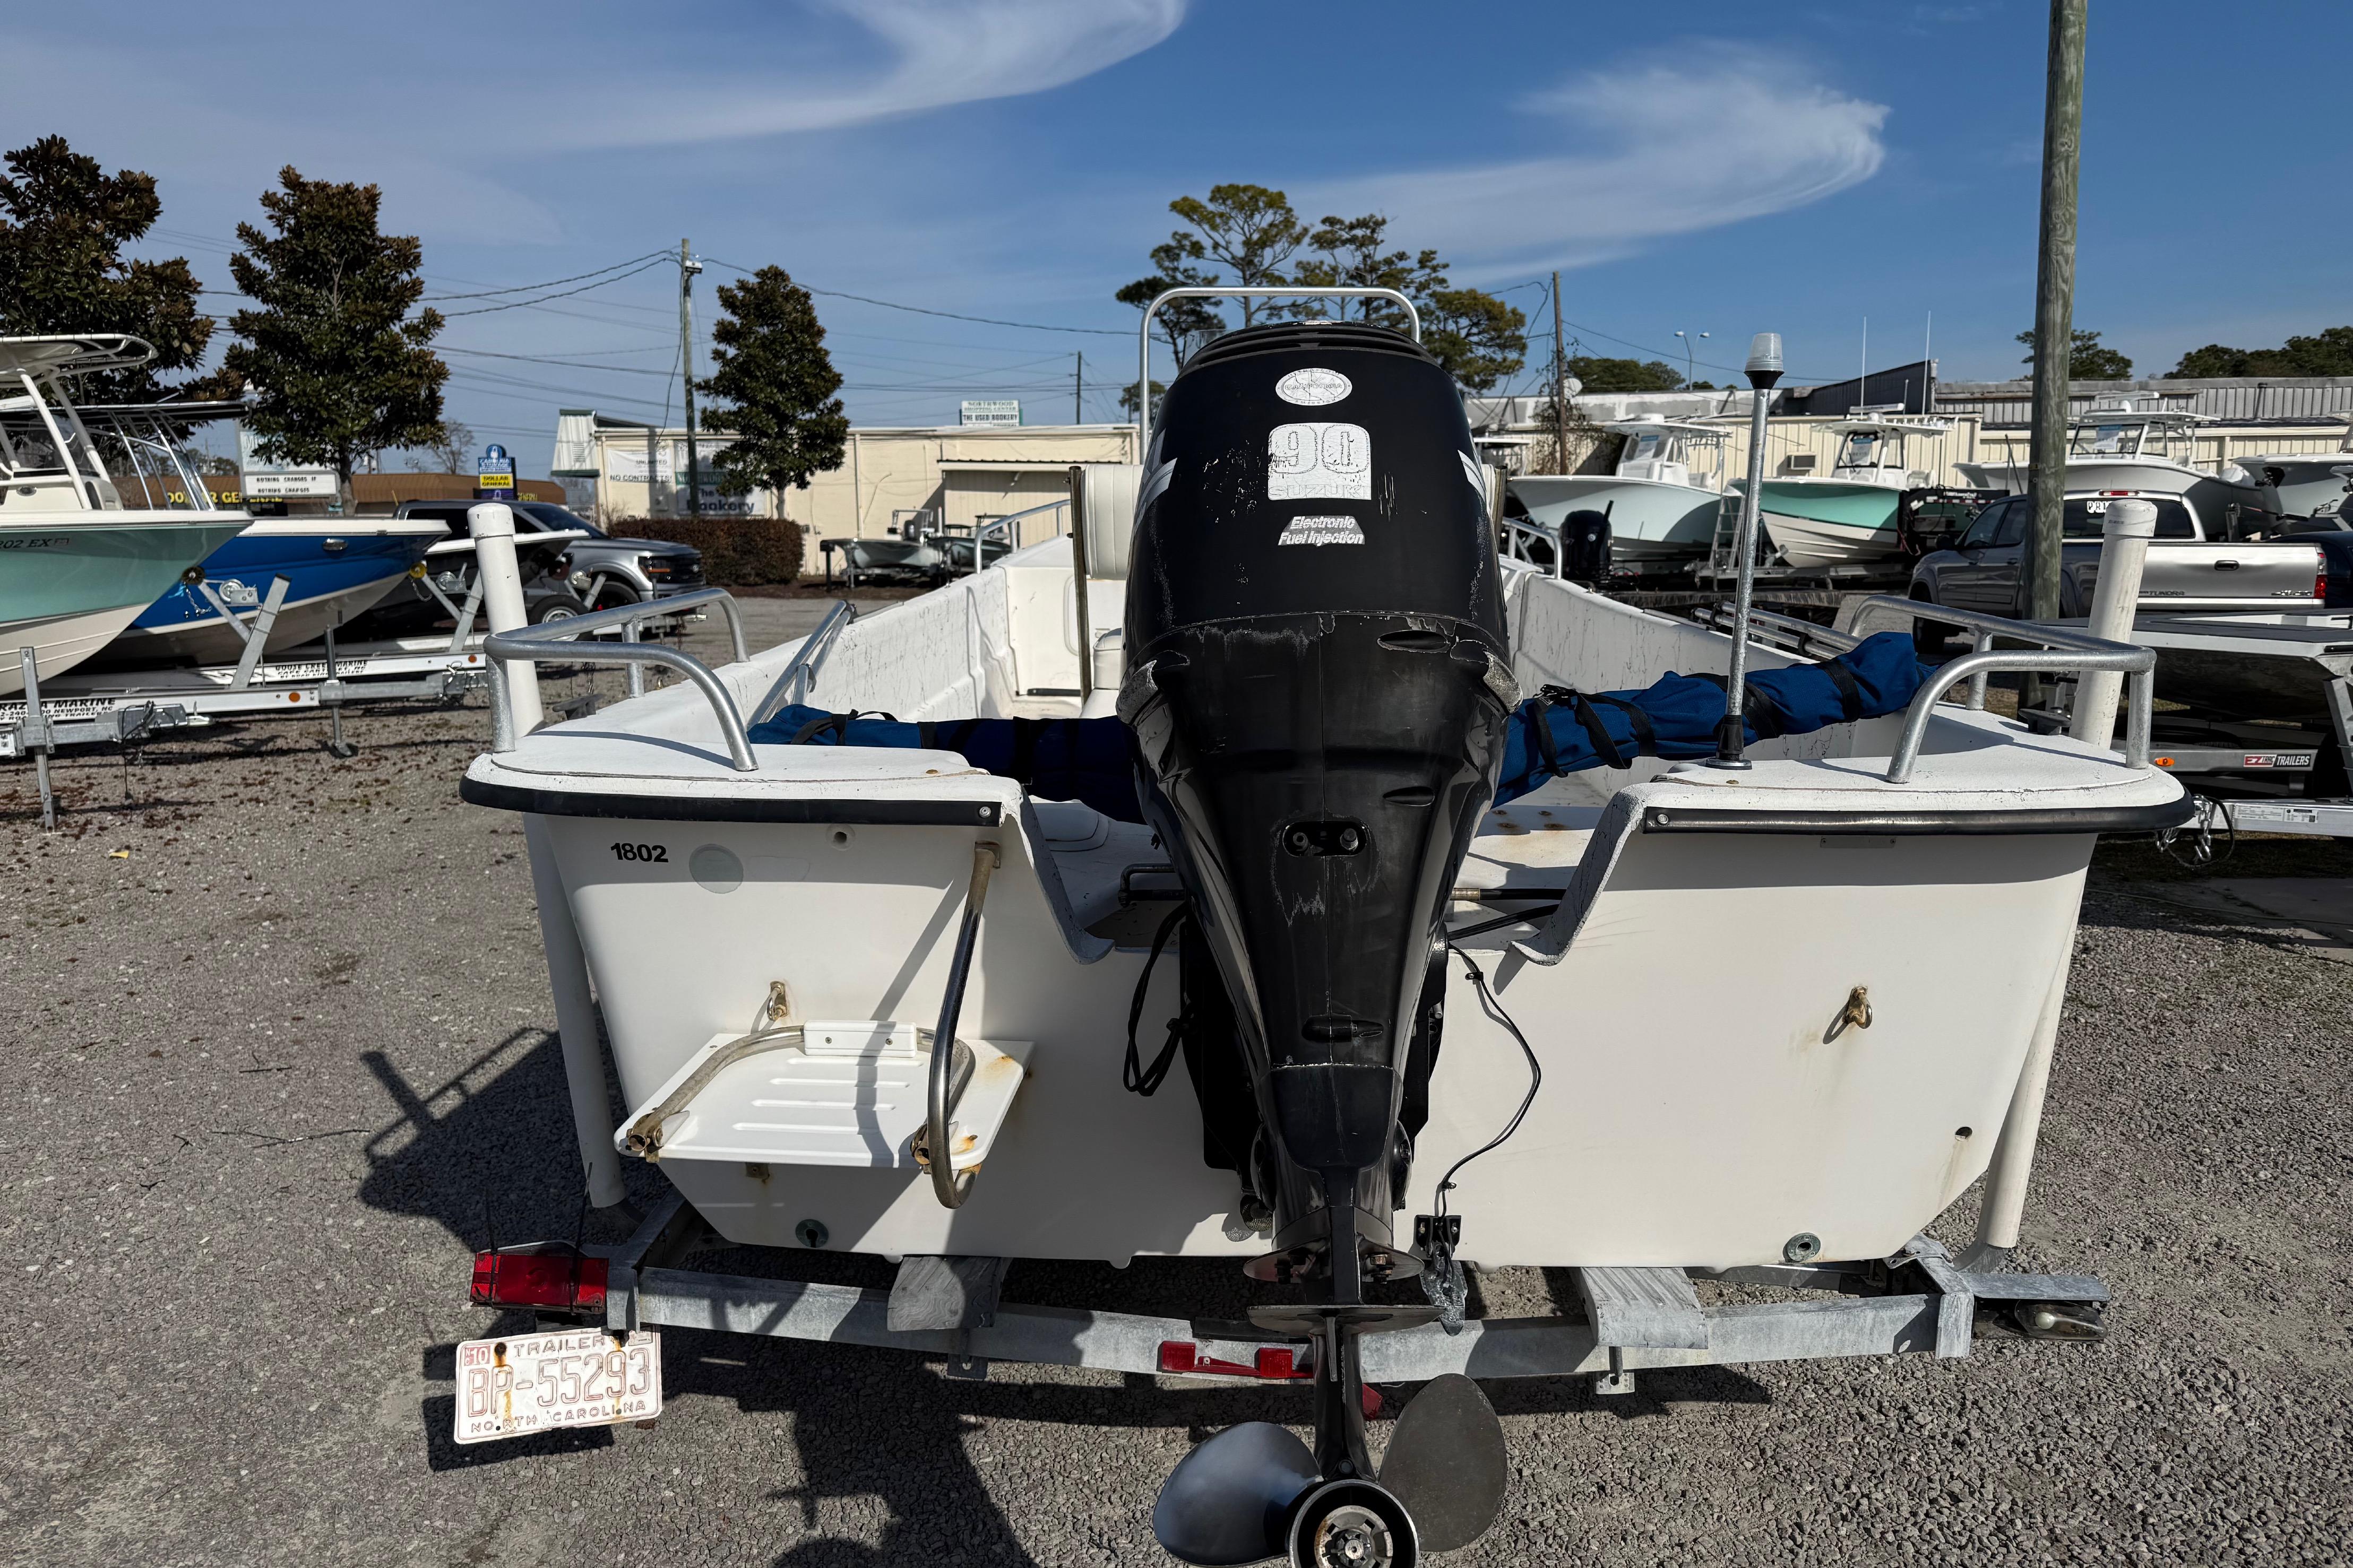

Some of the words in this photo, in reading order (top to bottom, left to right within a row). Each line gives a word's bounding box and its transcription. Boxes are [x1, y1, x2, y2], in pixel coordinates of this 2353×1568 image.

[1268, 424, 1369, 474] 90
[1269, 483, 1371, 499] SUZUKI
[1290, 516, 1356, 529] Electronic
[27, 539, 53, 548] EX
[1278, 531, 1308, 545] Fuel
[1308, 531, 1365, 547] Injection
[54, 698, 115, 708] MARINE
[2277, 756, 2310, 766] TRAILERS
[610, 843, 669, 863] 1802
[514, 1335, 605, 1357] TRAILER
[472, 1348, 488, 1365] 10
[469, 1348, 650, 1417] BP-55293
[471, 1415, 537, 1433] NORTH
[553, 1400, 646, 1422] CAROLINA
